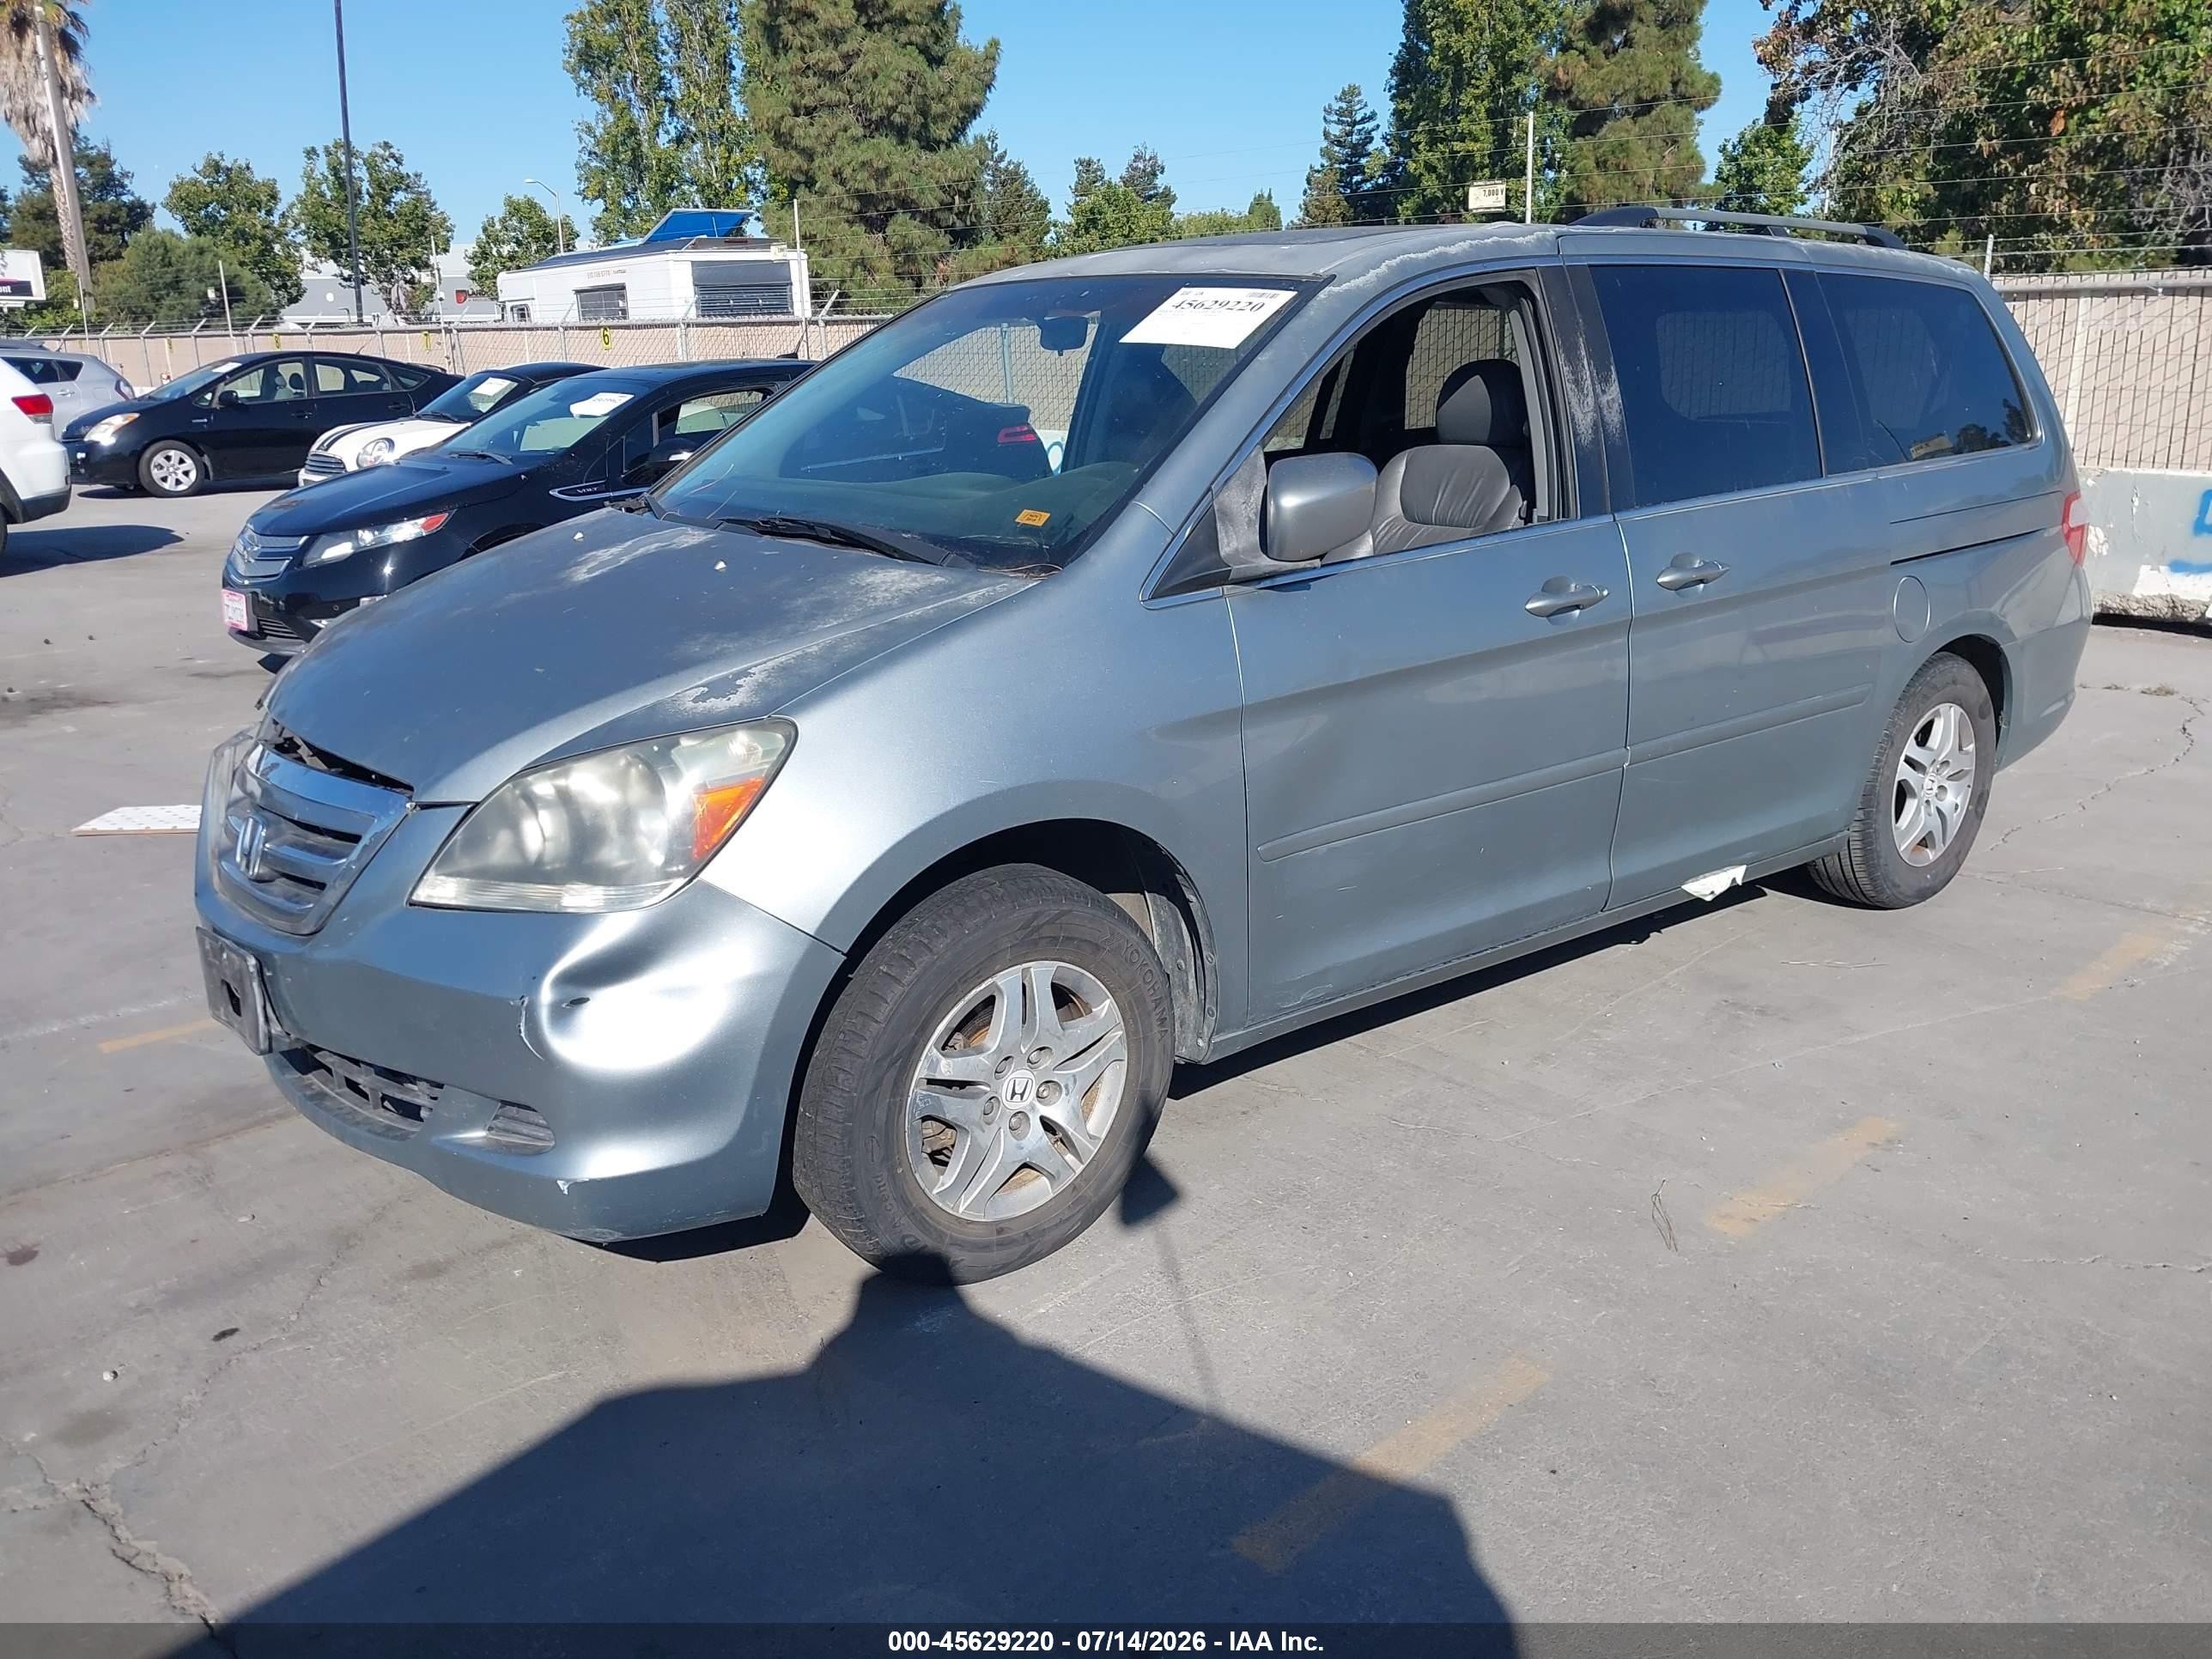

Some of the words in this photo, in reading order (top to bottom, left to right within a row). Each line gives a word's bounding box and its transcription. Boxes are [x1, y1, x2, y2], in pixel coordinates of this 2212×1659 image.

[1172, 298, 1266, 313] 45629220
[602, 327, 610, 345] 6
[1121, 938, 1170, 1043] YOKOHAMA
